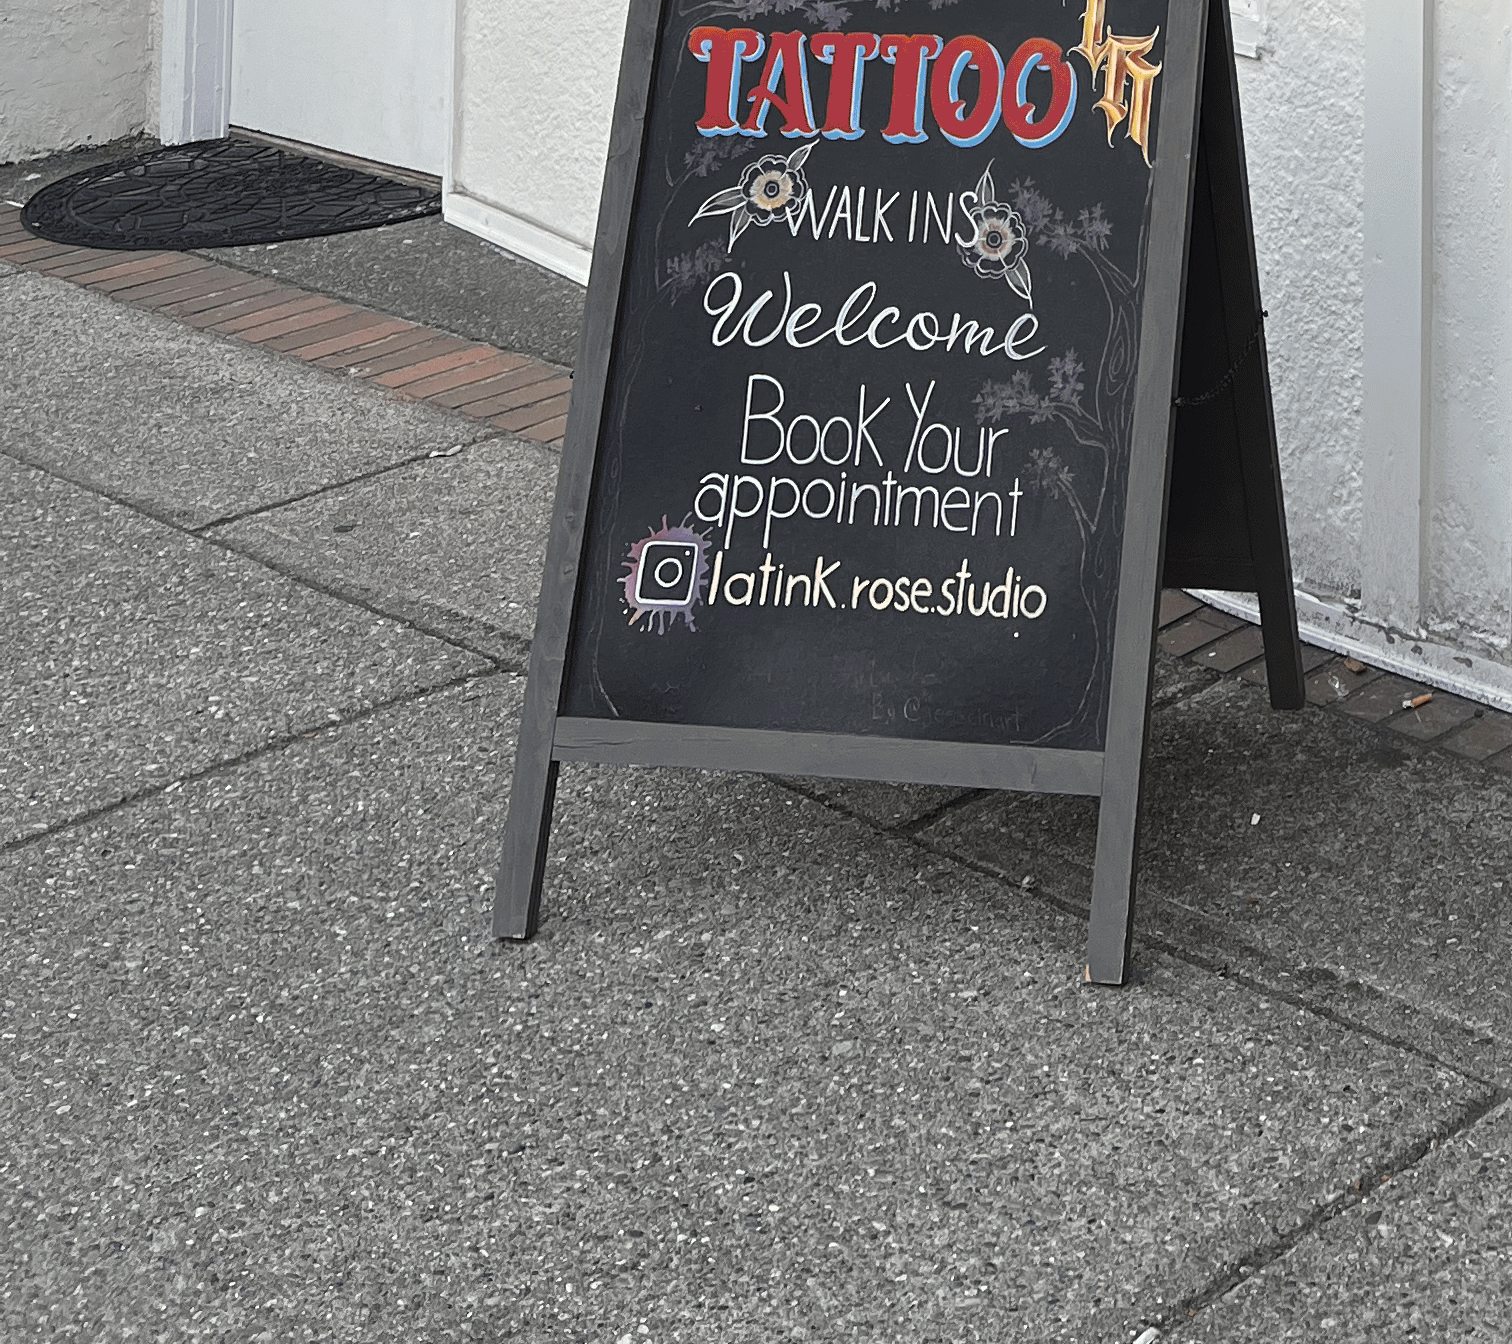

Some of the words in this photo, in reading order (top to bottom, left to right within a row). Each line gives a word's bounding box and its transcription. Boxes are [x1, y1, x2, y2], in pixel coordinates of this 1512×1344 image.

[688, 26, 1078, 149] TATTOO
[786, 184, 900, 244] WALK
[702, 270, 1048, 361] Welcome
[904, 379, 1010, 478] Your
[694, 470, 1024, 550] appointment
